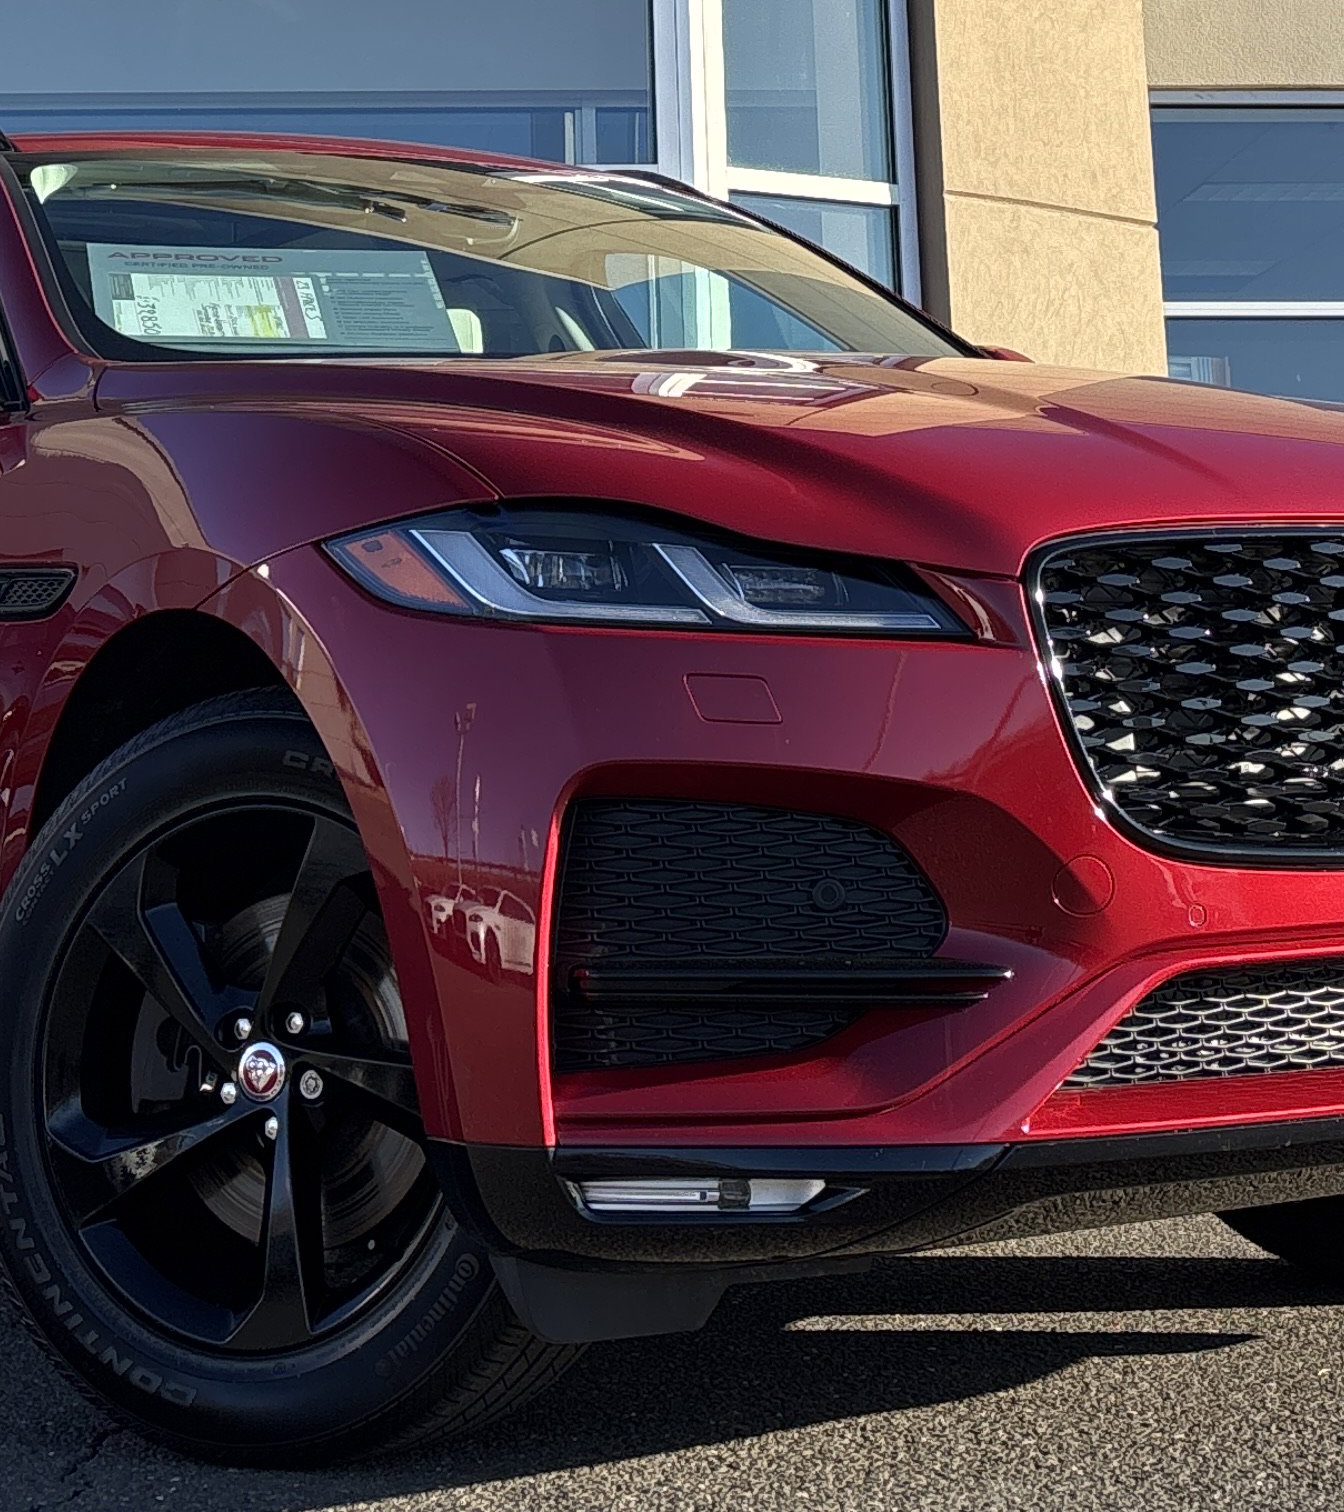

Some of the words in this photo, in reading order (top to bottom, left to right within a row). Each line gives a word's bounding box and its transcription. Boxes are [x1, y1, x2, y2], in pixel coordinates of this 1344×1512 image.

[107, 250, 283, 264] APPROVED
[124, 261, 188, 269] CERTIFIED
[192, 262, 270, 271] PRE-OWNED
[15, 862, 52, 922] CROSS
[50, 822, 84, 867] LX
[80, 777, 129, 825] SPORT
[387, 1252, 481, 1367] Continental
